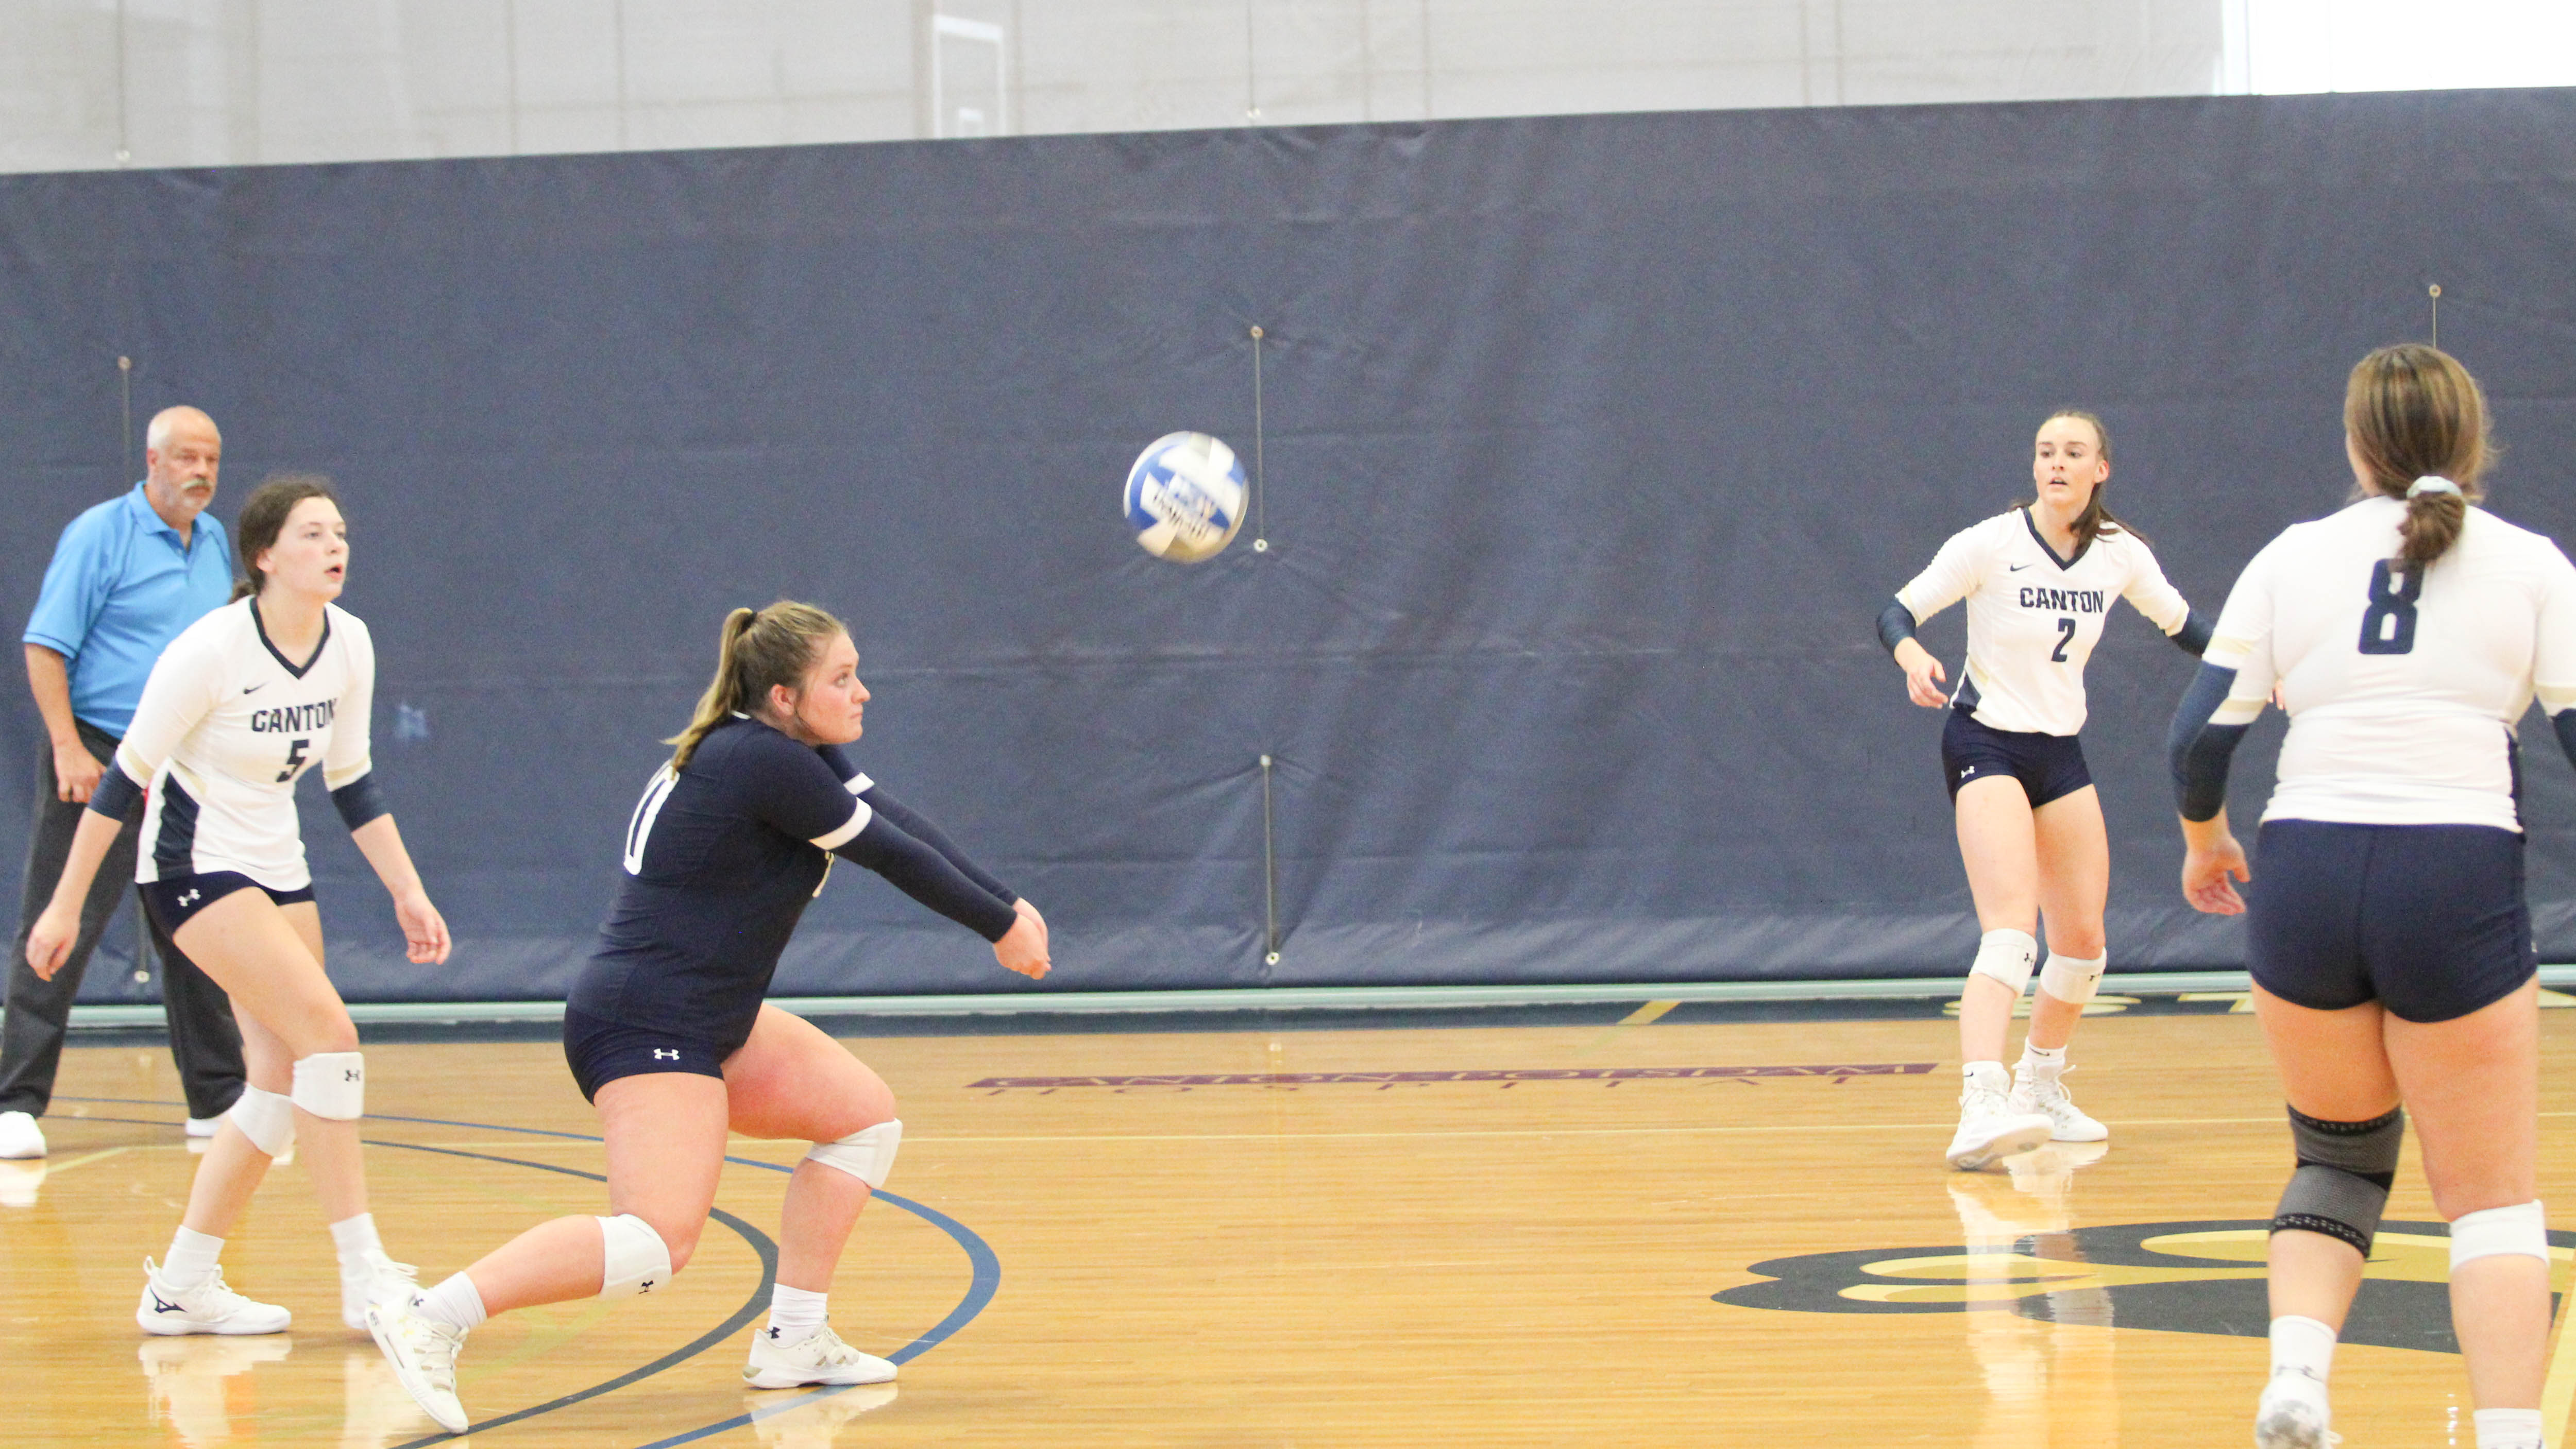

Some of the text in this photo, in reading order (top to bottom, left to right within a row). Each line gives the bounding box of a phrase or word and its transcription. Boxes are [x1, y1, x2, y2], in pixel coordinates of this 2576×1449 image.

[2020, 587, 2104, 613] CANTON
[2358, 558, 2425, 655] 8
[2051, 618, 2076, 662] 2
[276, 739, 309, 782] 5
